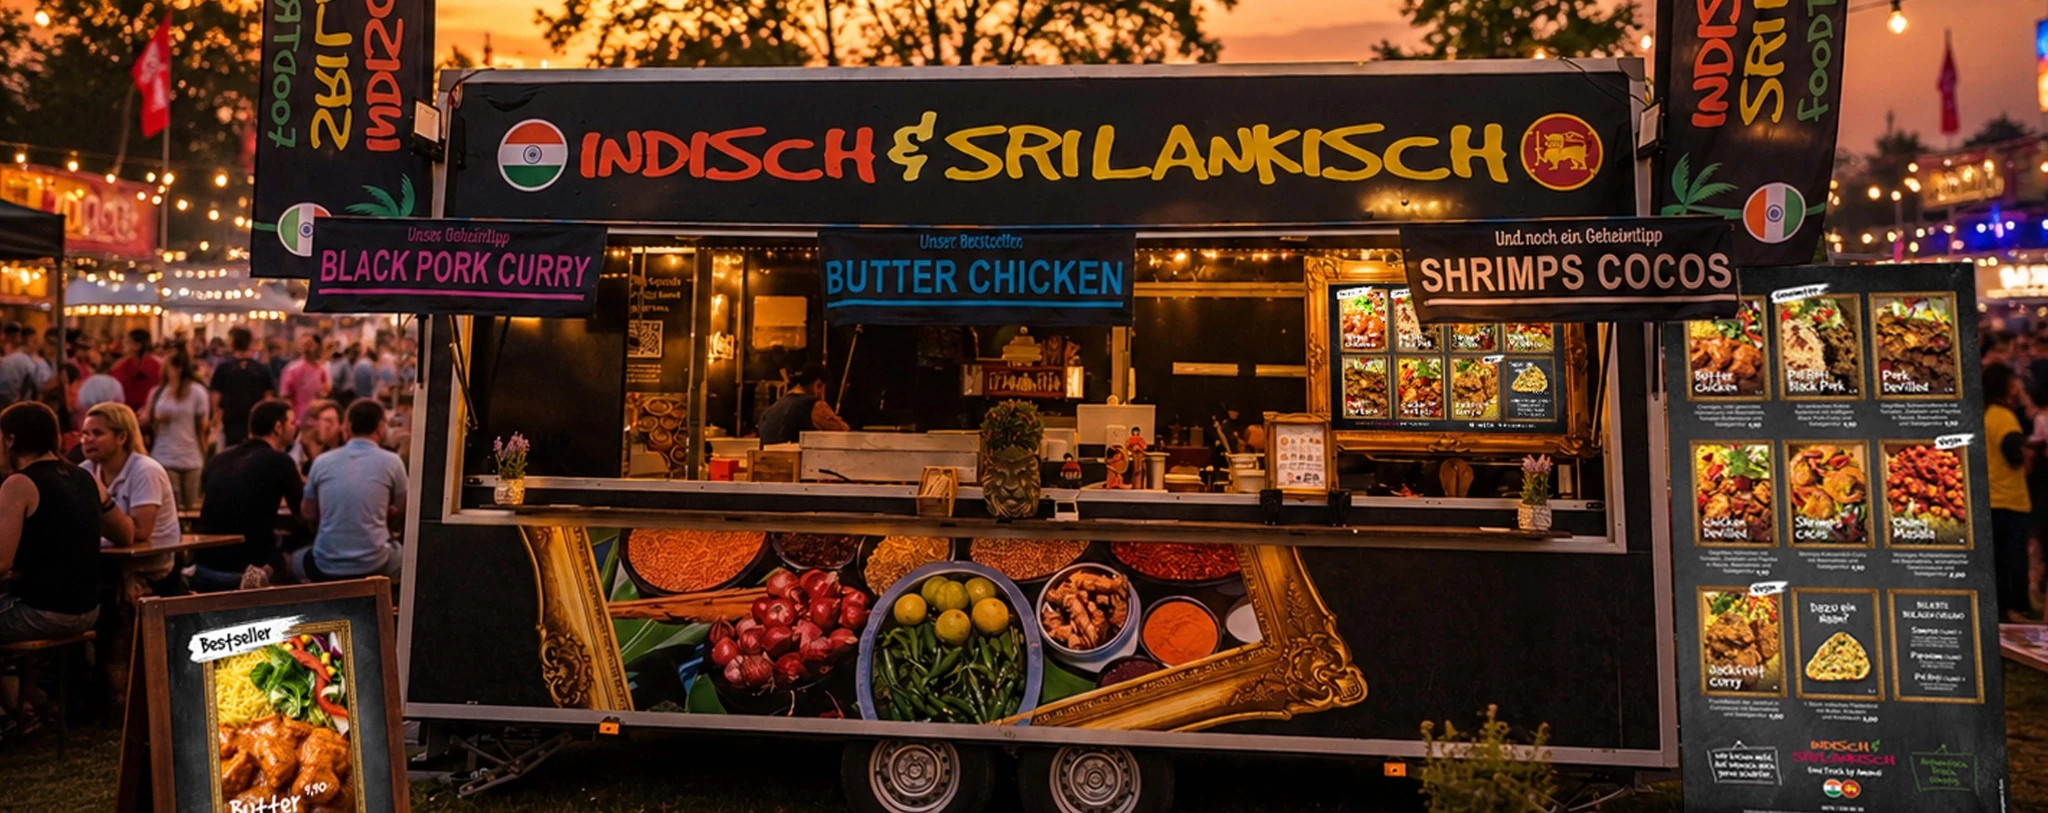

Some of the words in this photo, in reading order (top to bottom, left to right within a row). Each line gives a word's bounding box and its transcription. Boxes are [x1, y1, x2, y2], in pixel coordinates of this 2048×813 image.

[580, 127, 876, 184] INDISCH
[887, 110, 936, 182] &
[1496, 231, 1524, 246] Und
[1526, 230, 1558, 246] noch
[1562, 230, 1583, 245] ein
[1586, 228, 1662, 247] Geheimtipp
[320, 250, 410, 282] BLACK
[416, 251, 491, 284] PORK
[498, 253, 591, 288] CURRY
[826, 260, 958, 294] BUTTER
[968, 260, 1123, 294] CHICKEN
[1420, 254, 1584, 293] SHRIMPS
[1597, 253, 1732, 290] COCOS
[1694, 370, 1734, 381] Butter
[1882, 370, 1910, 381] Pork
[1788, 382, 1817, 392] Black
[1820, 381, 1846, 391] Pork
[1883, 382, 1929, 392] Devilled
[200, 628, 271, 654] Bestseller
[1810, 740, 1869, 752] INDISCH
[305, 782, 327, 797] 9,90
[230, 794, 301, 813] Butter
